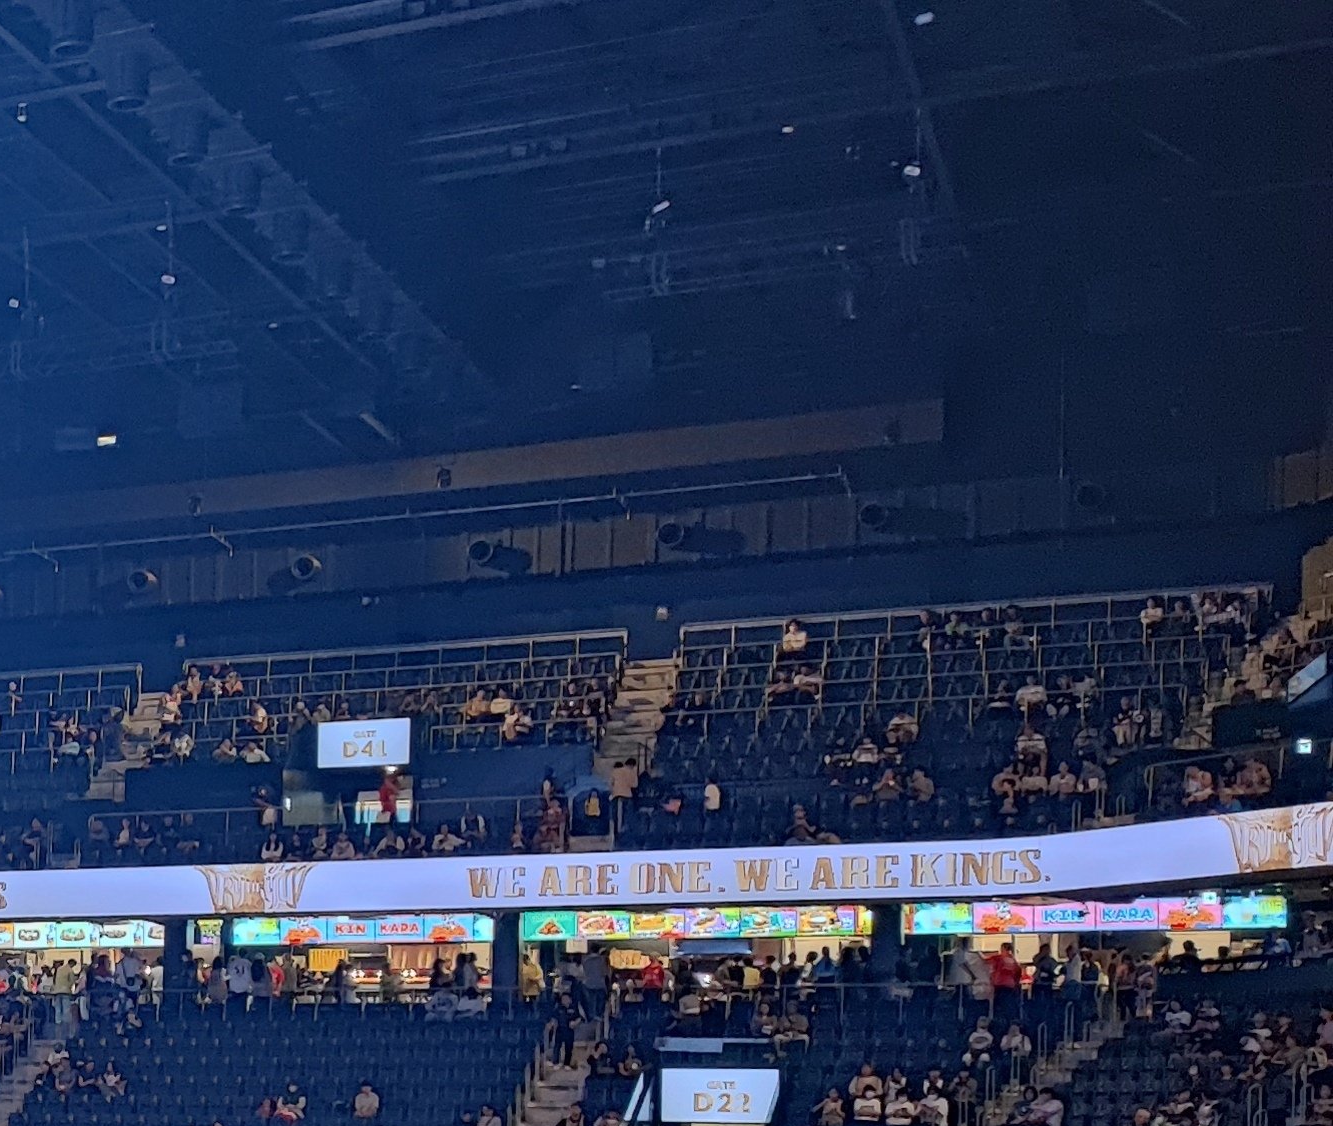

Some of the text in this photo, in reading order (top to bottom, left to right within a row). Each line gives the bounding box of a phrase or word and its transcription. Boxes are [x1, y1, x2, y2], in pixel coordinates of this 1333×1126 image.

[343, 740, 388, 758] D41
[467, 847, 1051, 900] WE ARE ONE. WE ARE KINGS.
[1101, 907, 1155, 922] KARA
[335, 923, 366, 936] KIN
[706, 1080, 736, 1090] GATE
[693, 1091, 752, 1113] D22
